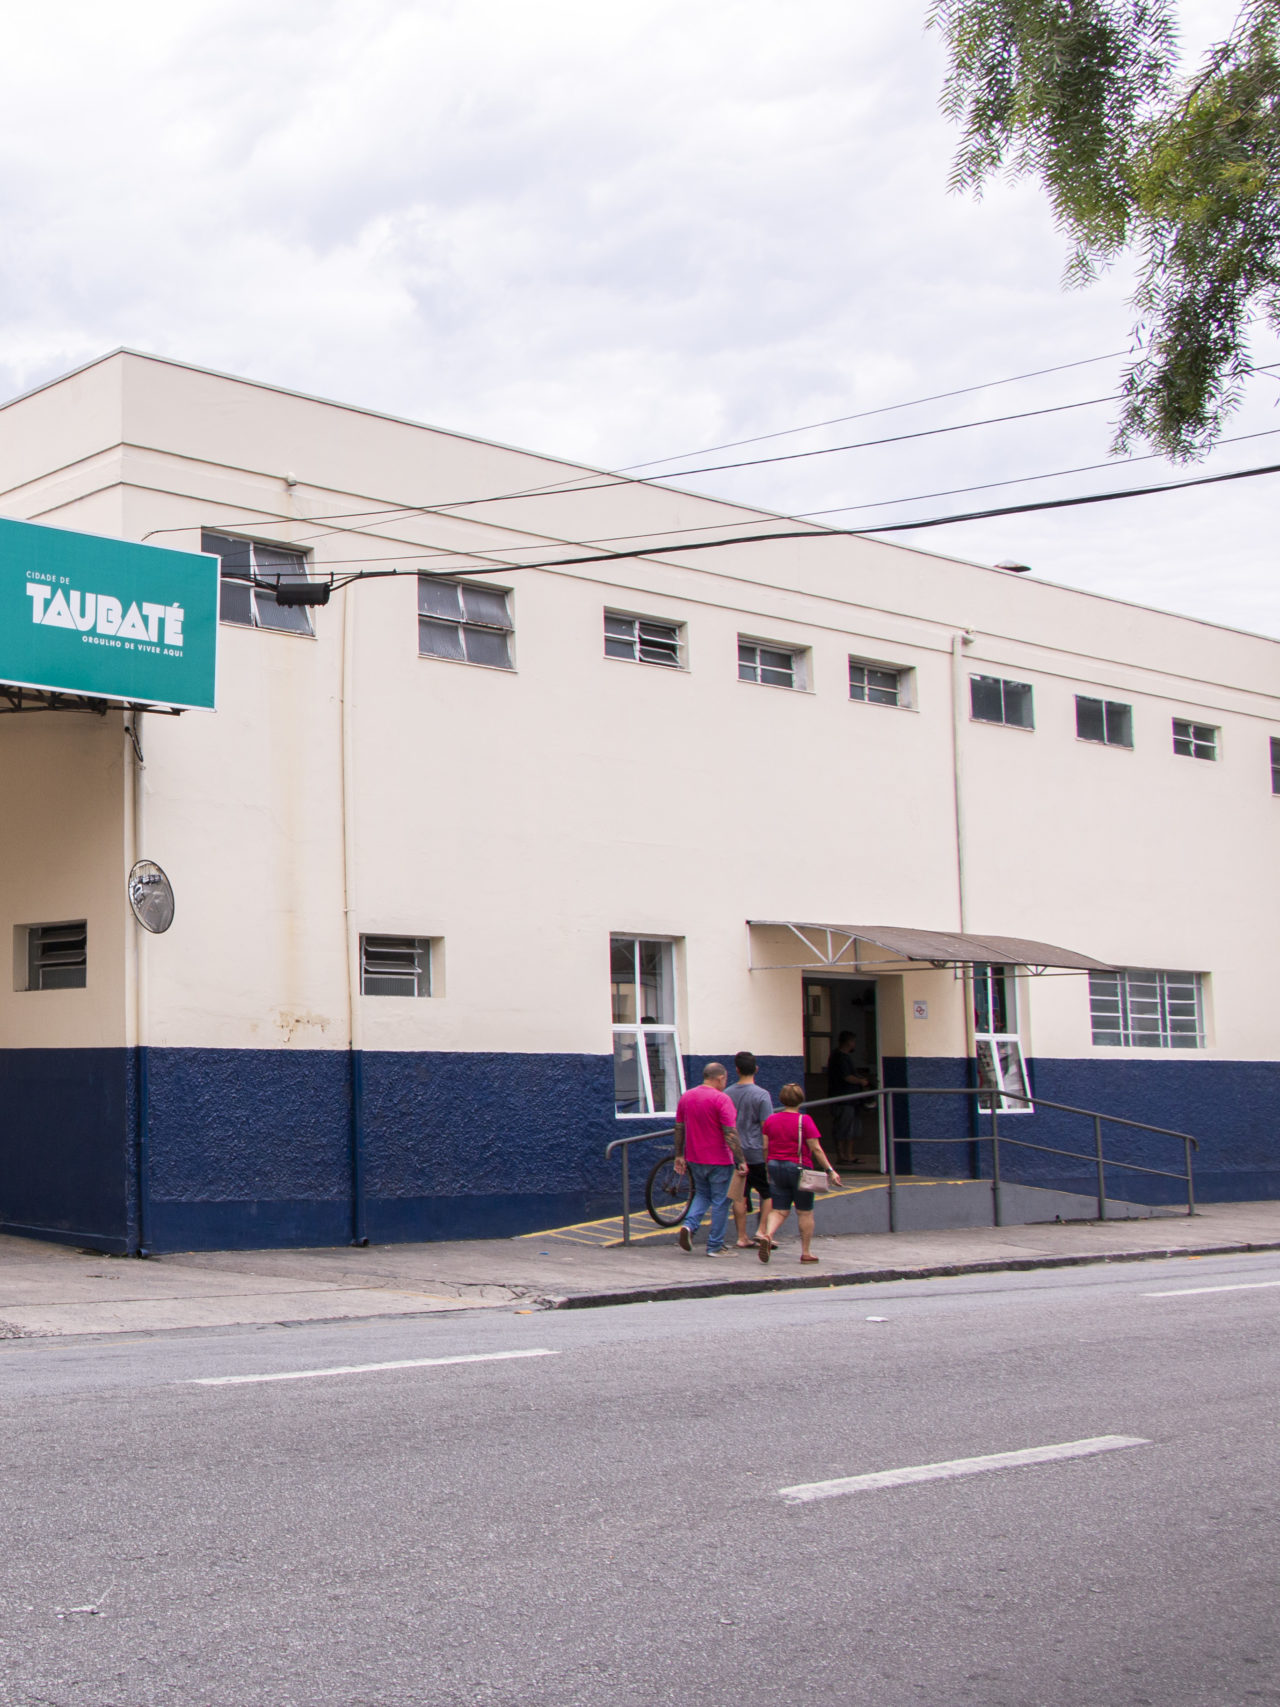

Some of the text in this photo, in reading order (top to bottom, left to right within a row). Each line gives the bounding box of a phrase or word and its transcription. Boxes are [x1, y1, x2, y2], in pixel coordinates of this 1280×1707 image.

[26, 571, 70, 585] CIDADE DE
[26, 582, 184, 646] TAUBATÉ
[82, 635, 183, 657] ORGULHO DE VIVER AQUI
